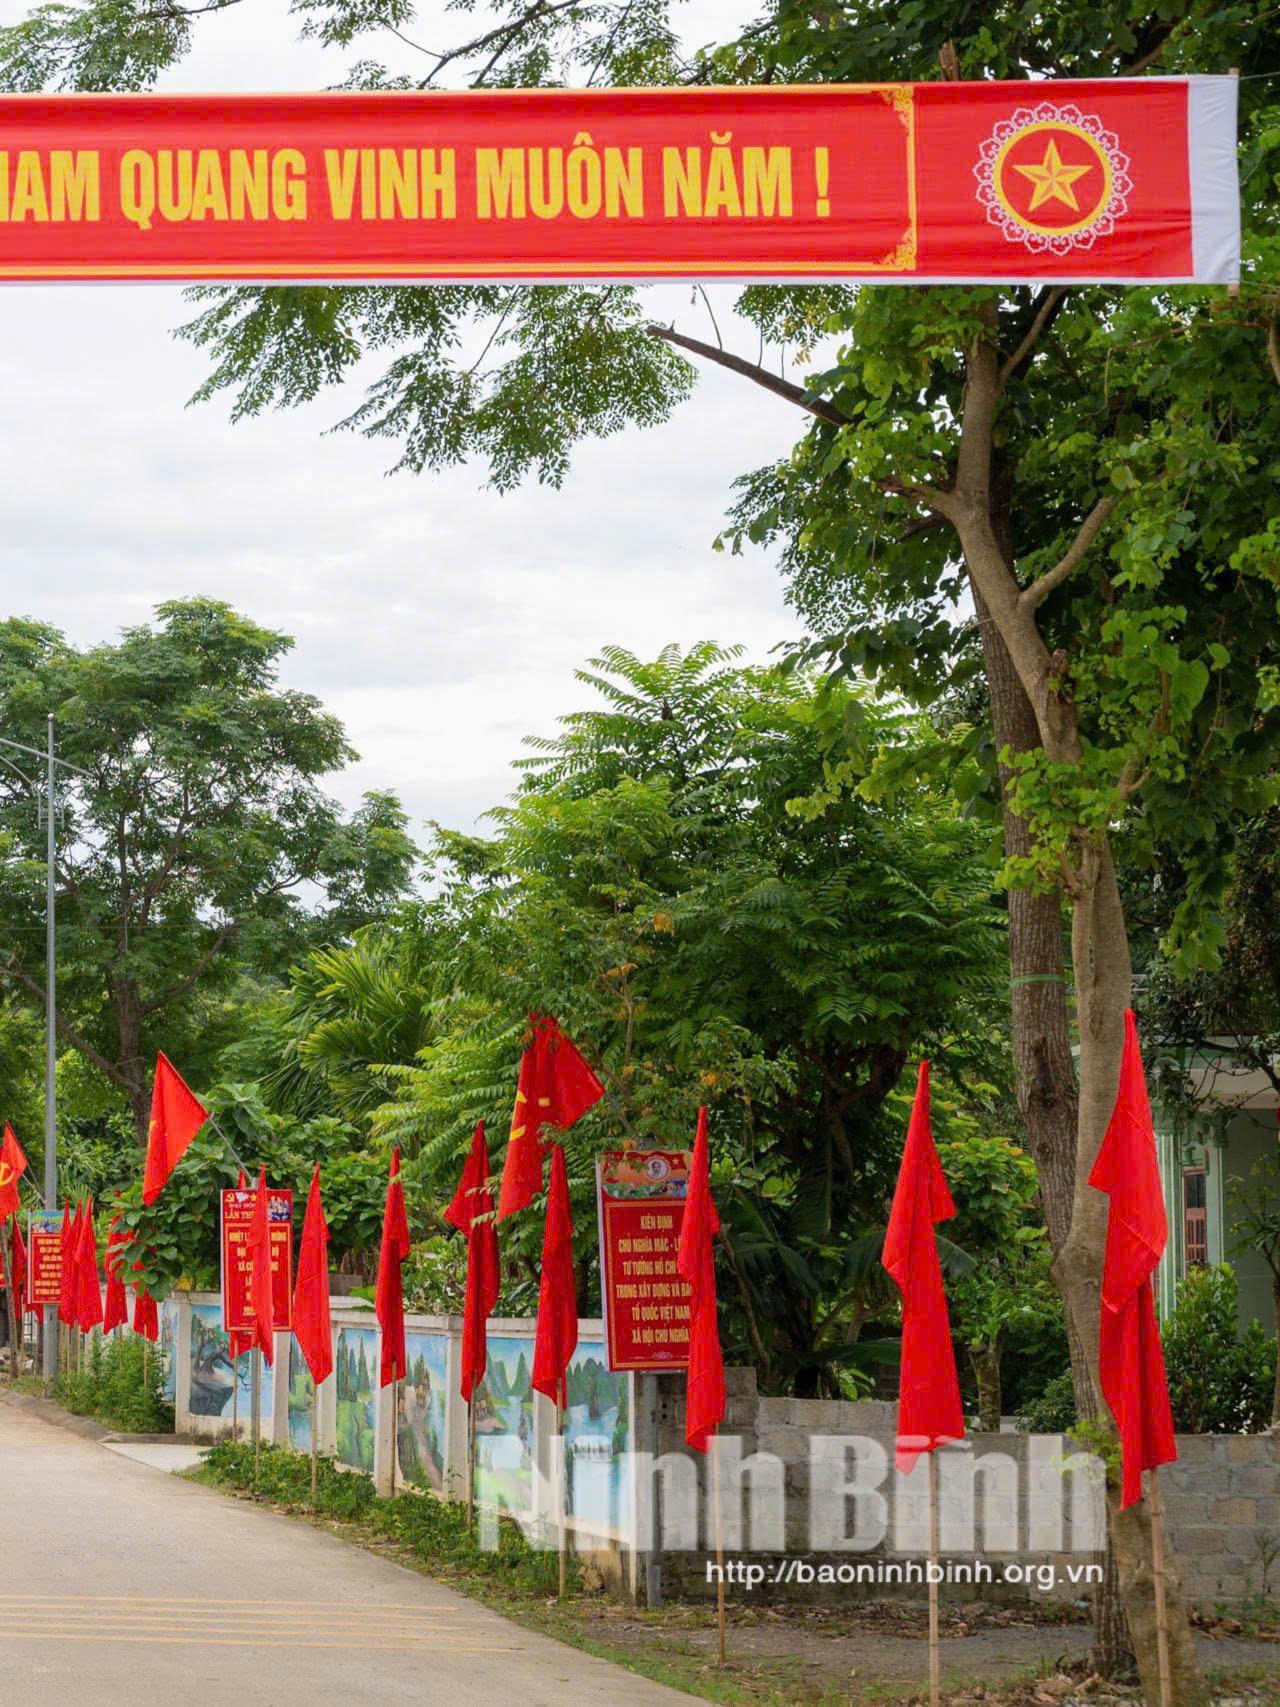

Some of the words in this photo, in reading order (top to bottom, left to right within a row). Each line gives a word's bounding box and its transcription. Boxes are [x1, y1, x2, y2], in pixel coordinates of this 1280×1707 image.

[120, 148, 306, 230] QUANG
[324, 148, 455, 219] VINH
[476, 131, 643, 219] MUÔN
[663, 131, 793, 217] NĂM
[815, 147, 830, 217] !
[640, 1212, 656, 1230] KIÊN
[618, 1233, 632, 1254] CHỦ
[632, 1235, 653, 1253] NGHĨA
[654, 1234, 669, 1253] MÁC
[615, 1284, 637, 1299] TRONG
[638, 1280, 651, 1298] XÂY
[652, 1282, 670, 1300] DỰNG
[641, 1301, 659, 1322] QUỐC
[659, 1303, 673, 1323] VIỆT
[674, 1305, 690, 1320] NAM
[669, 1325, 690, 1343] NGHĨA
